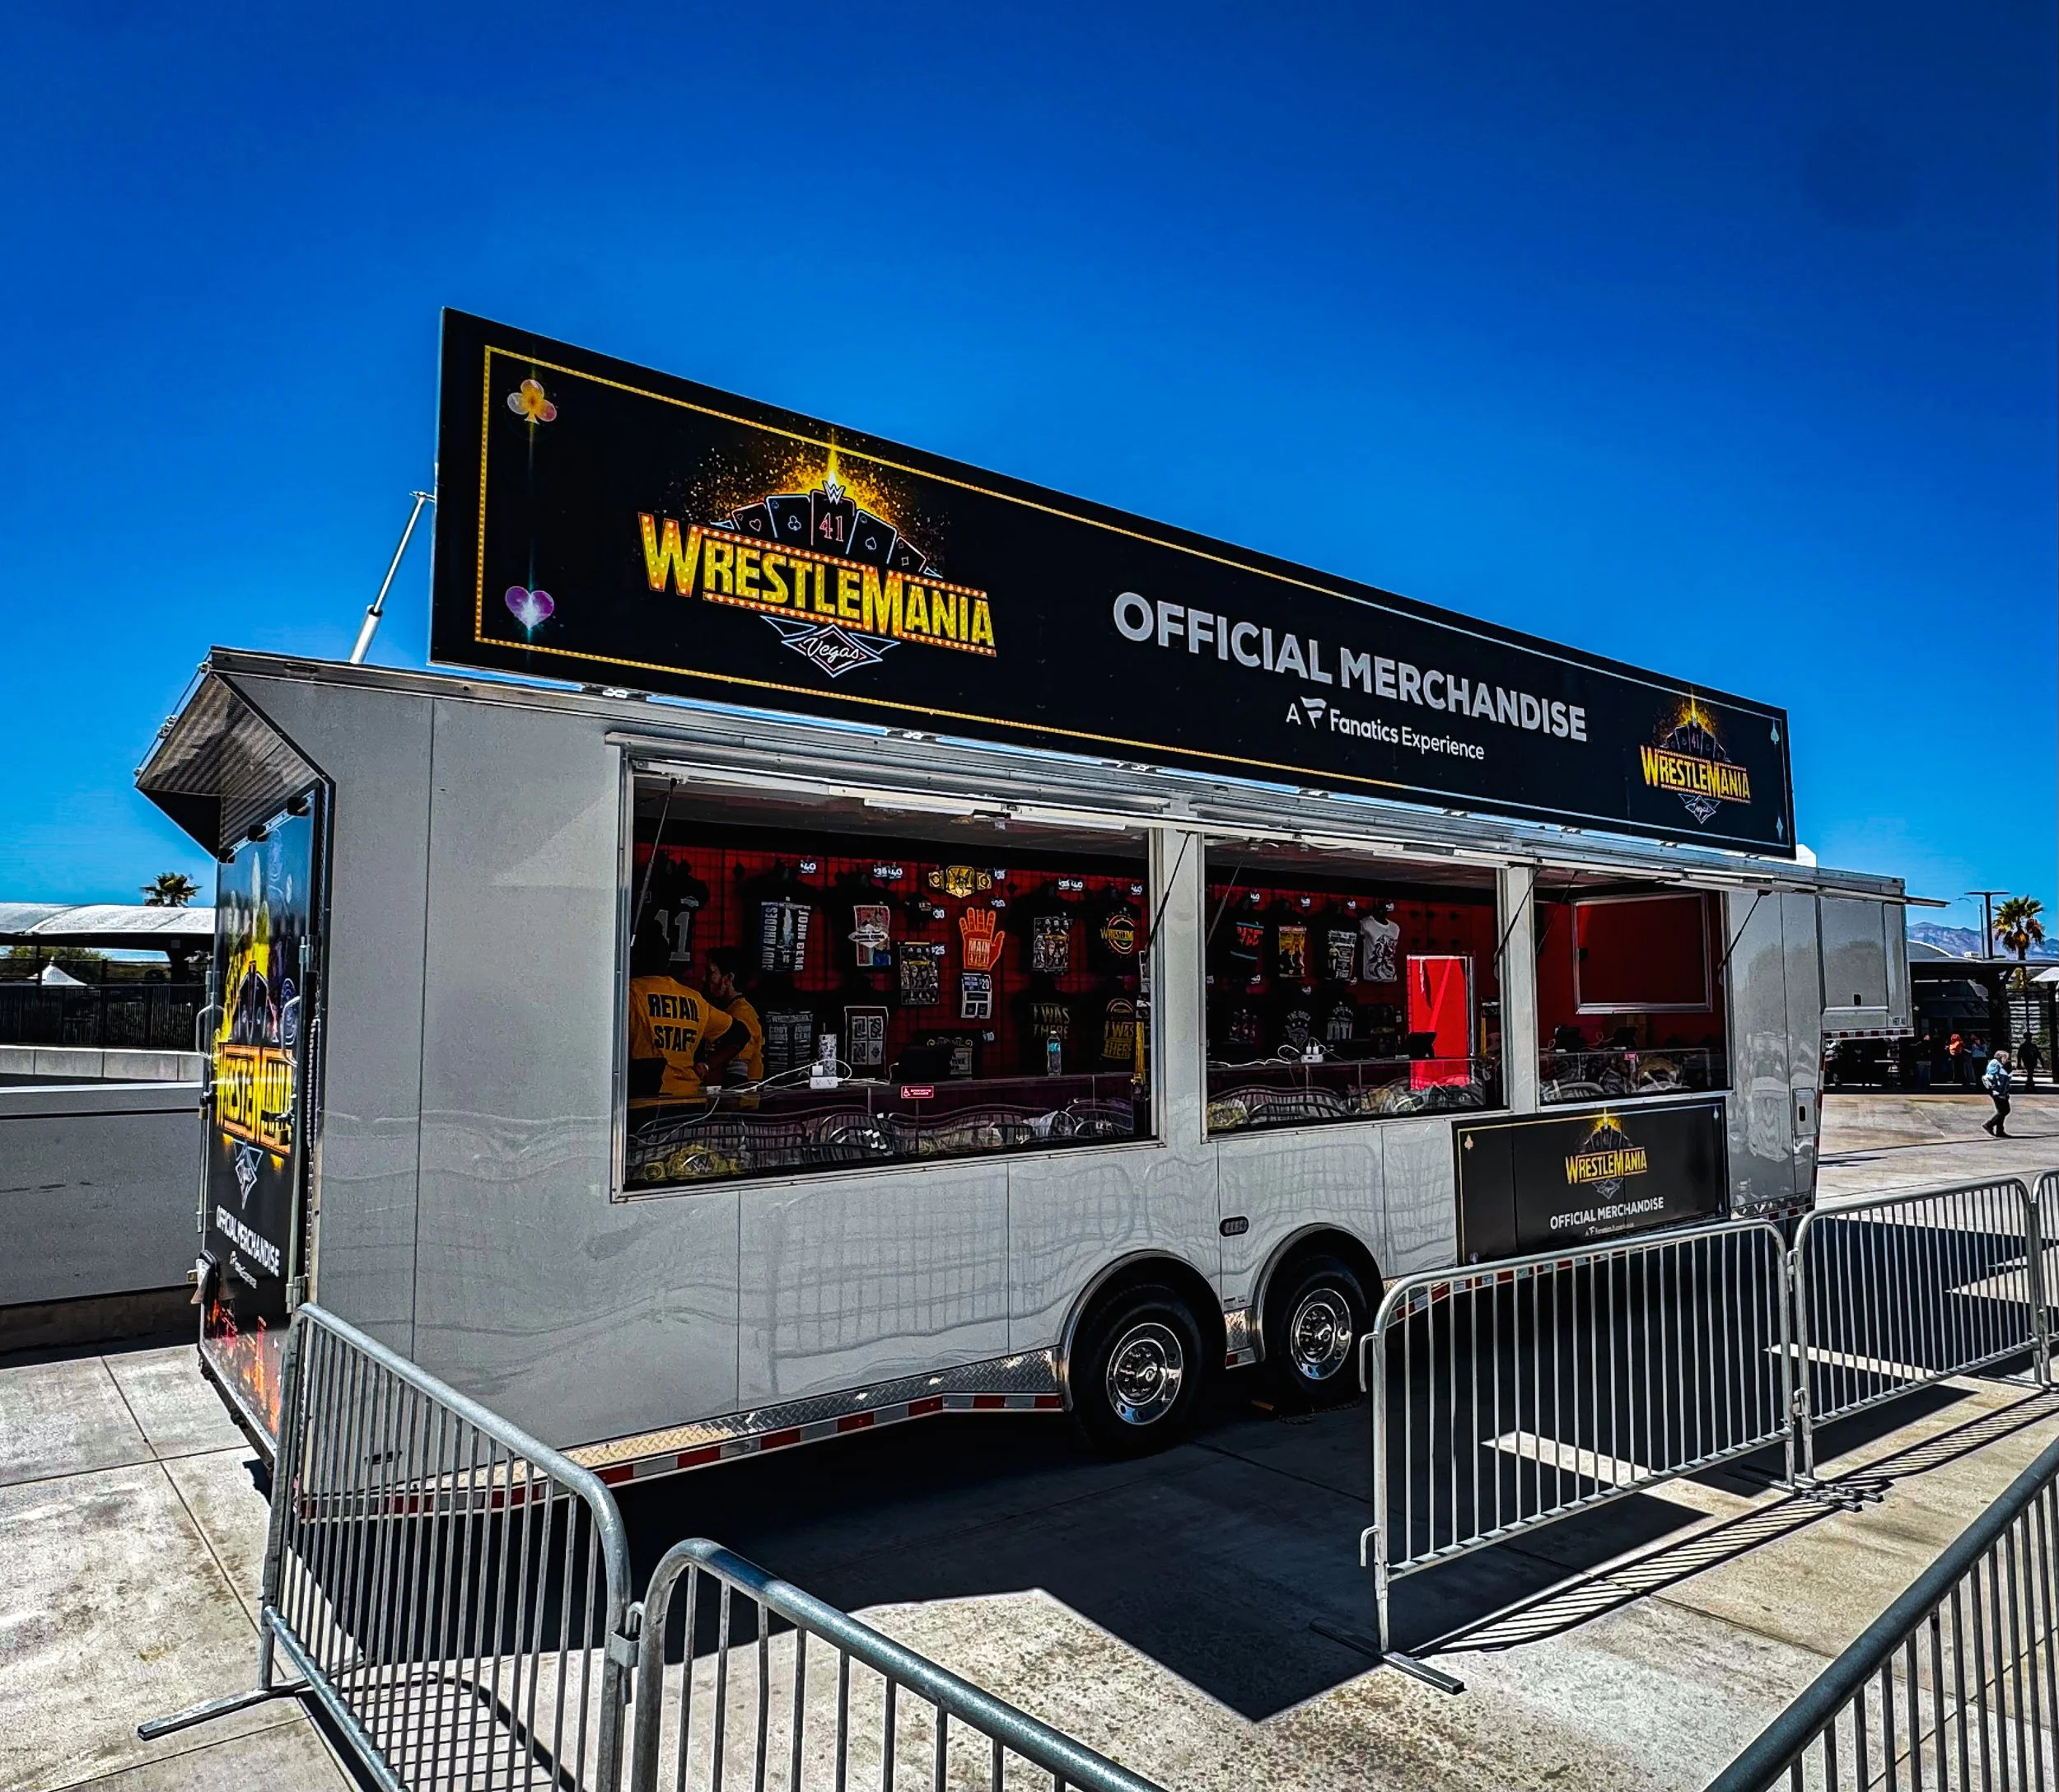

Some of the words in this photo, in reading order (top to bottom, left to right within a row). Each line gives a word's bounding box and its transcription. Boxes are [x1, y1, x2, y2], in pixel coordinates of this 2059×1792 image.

[819, 512, 844, 543] 41
[803, 635, 861, 665] Vegas
[1113, 591, 1333, 685] OFFICIAL
[1339, 646, 1588, 741] MERCHANDISE
[1286, 702, 1302, 726] A
[1329, 709, 1399, 744] Fanatics
[1401, 726, 1486, 761] Experience
[1639, 744, 1751, 800] WRESTLEMANIA
[763, 907, 779, 945] RHODES
[969, 939, 991, 953] MAIN
[647, 993, 699, 1023] RETAIL
[1041, 1006, 1071, 1025] WAS
[1112, 1020, 1134, 1039] WAS
[1566, 1149, 1648, 1184] WRESTLEMANIA
[1549, 1210, 1596, 1230] OFFICIAL
[1597, 1196, 1664, 1220] MERCHANDISE
